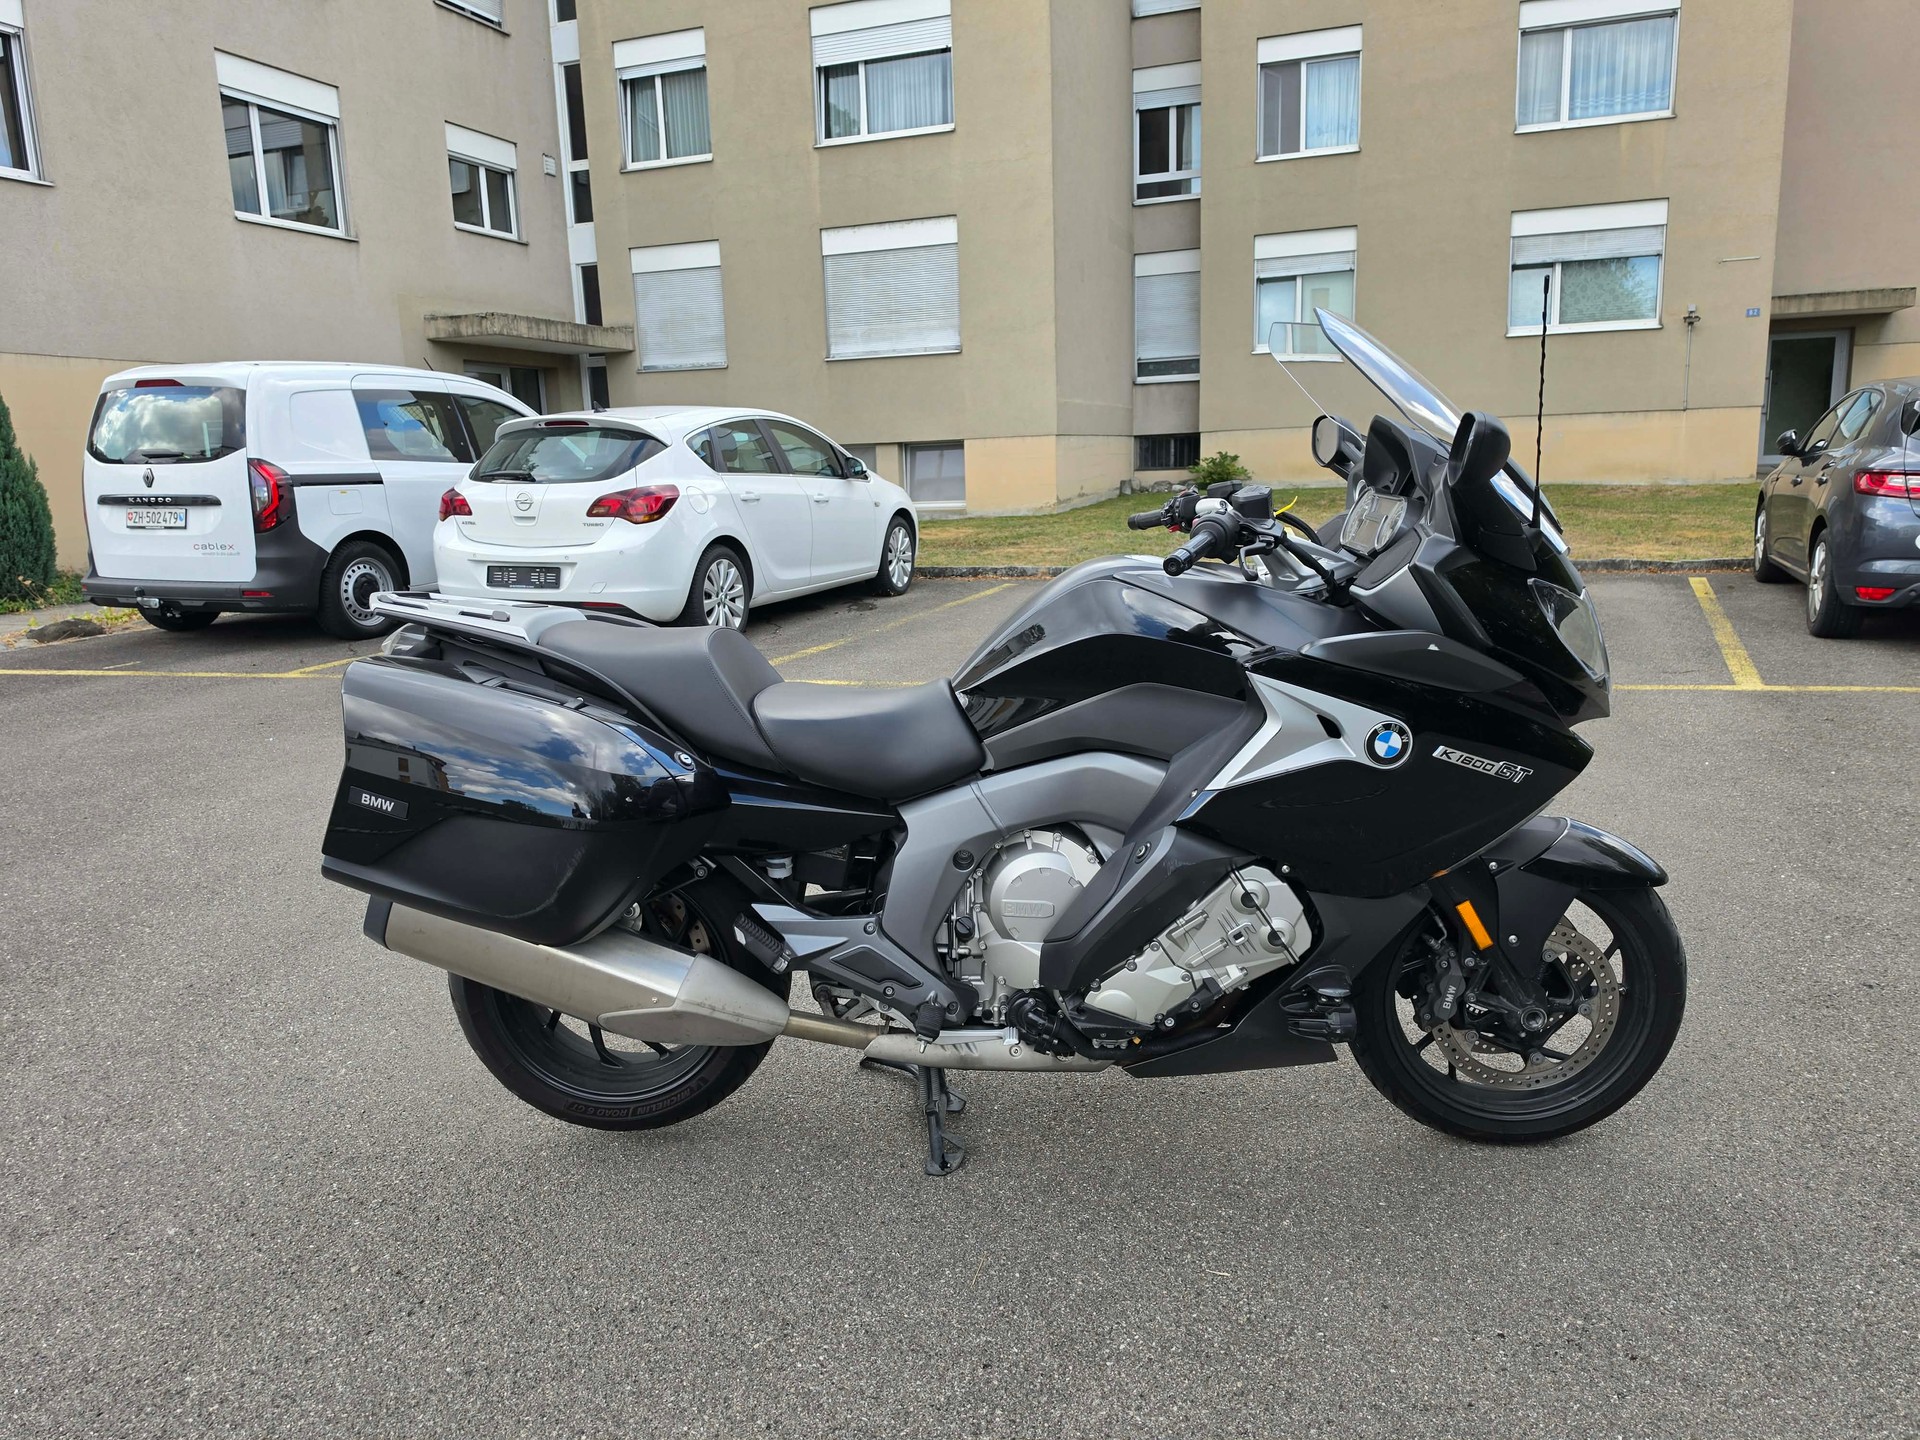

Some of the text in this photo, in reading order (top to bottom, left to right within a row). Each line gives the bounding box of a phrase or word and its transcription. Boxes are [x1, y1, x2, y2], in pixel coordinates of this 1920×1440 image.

[193, 542, 235, 551] cablex
[1375, 723, 1410, 743] BMW
[361, 793, 395, 812] BMW
[1004, 902, 1044, 916] BMW
[1442, 985, 1457, 1010] BMW
